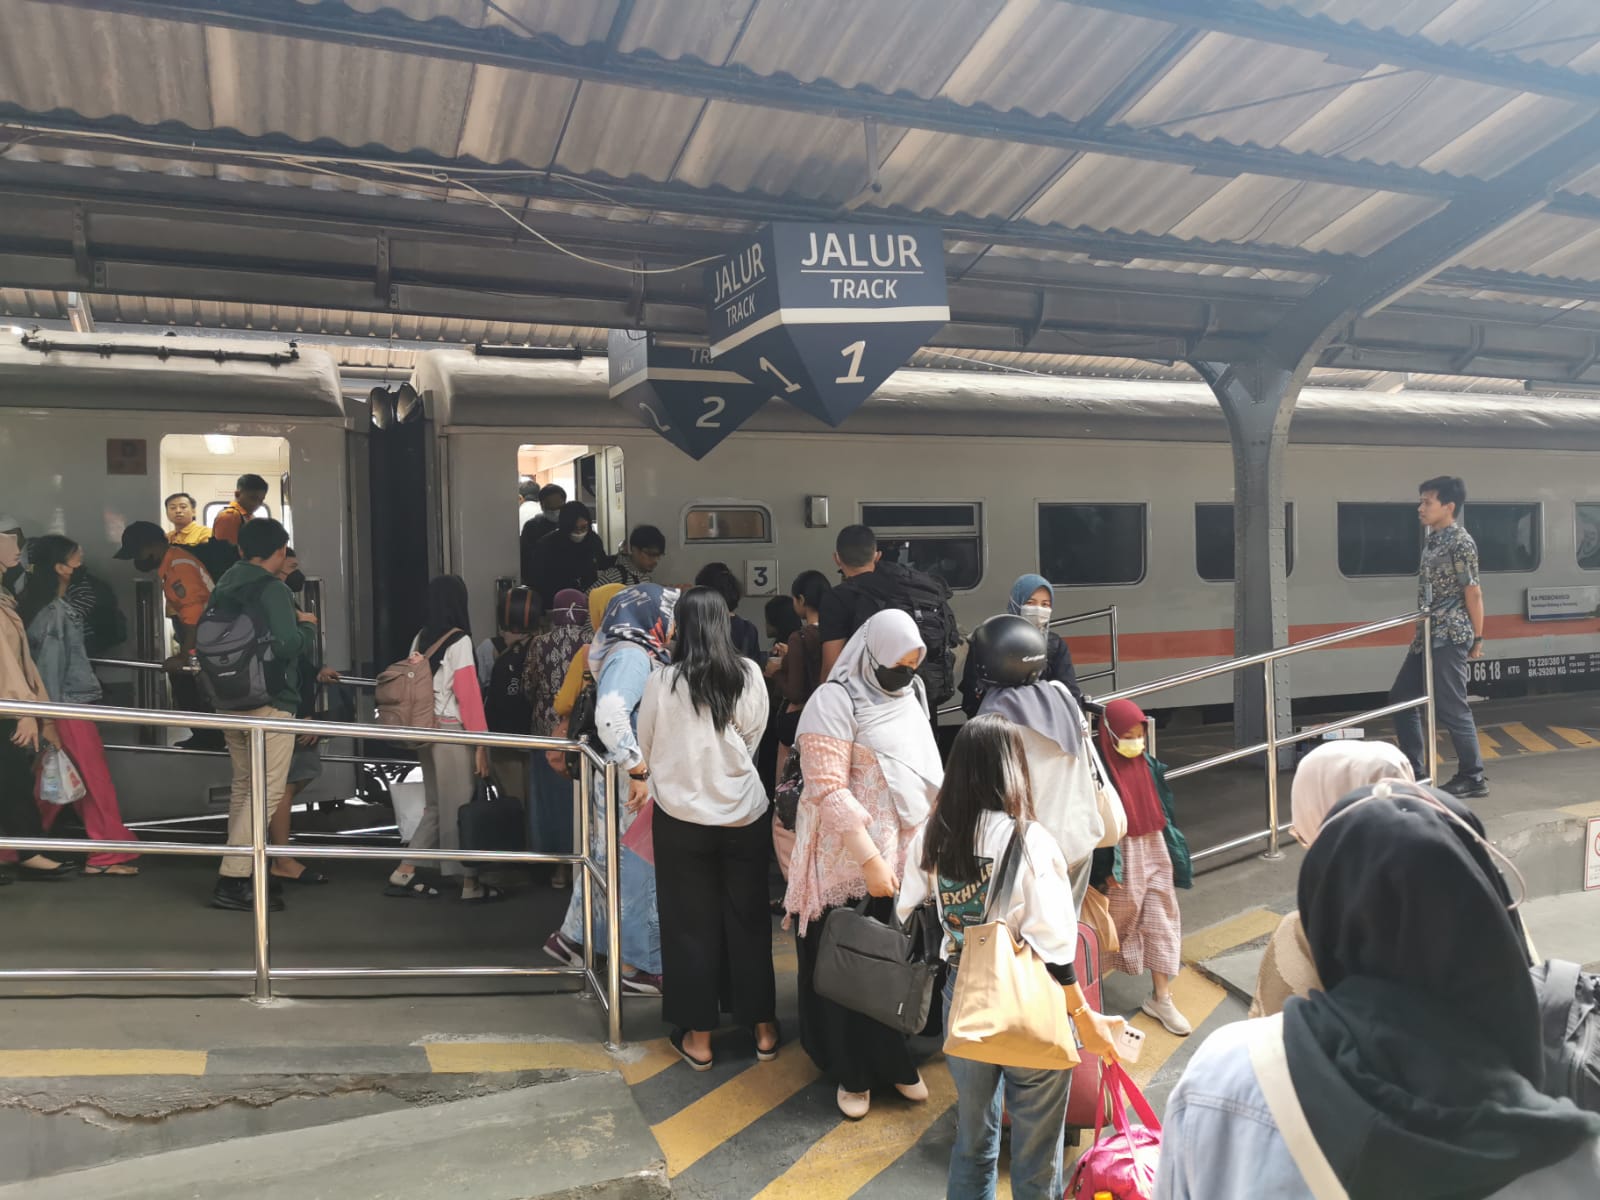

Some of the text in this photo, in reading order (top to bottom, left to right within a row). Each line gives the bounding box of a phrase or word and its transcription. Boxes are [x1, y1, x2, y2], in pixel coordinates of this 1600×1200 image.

[801, 232, 922, 268] JALUR
[714, 242, 765, 304] JALUR
[830, 278, 898, 300] TRACK
[726, 293, 756, 329] TRACK
[690, 347, 714, 365] TR
[835, 340, 867, 384] 1
[759, 356, 802, 394] 1
[695, 396, 726, 428] 2
[753, 566, 768, 587] 3
[1474, 661, 1487, 682] 66
[1489, 660, 1501, 680] 18
[1507, 665, 1521, 675] KTG
